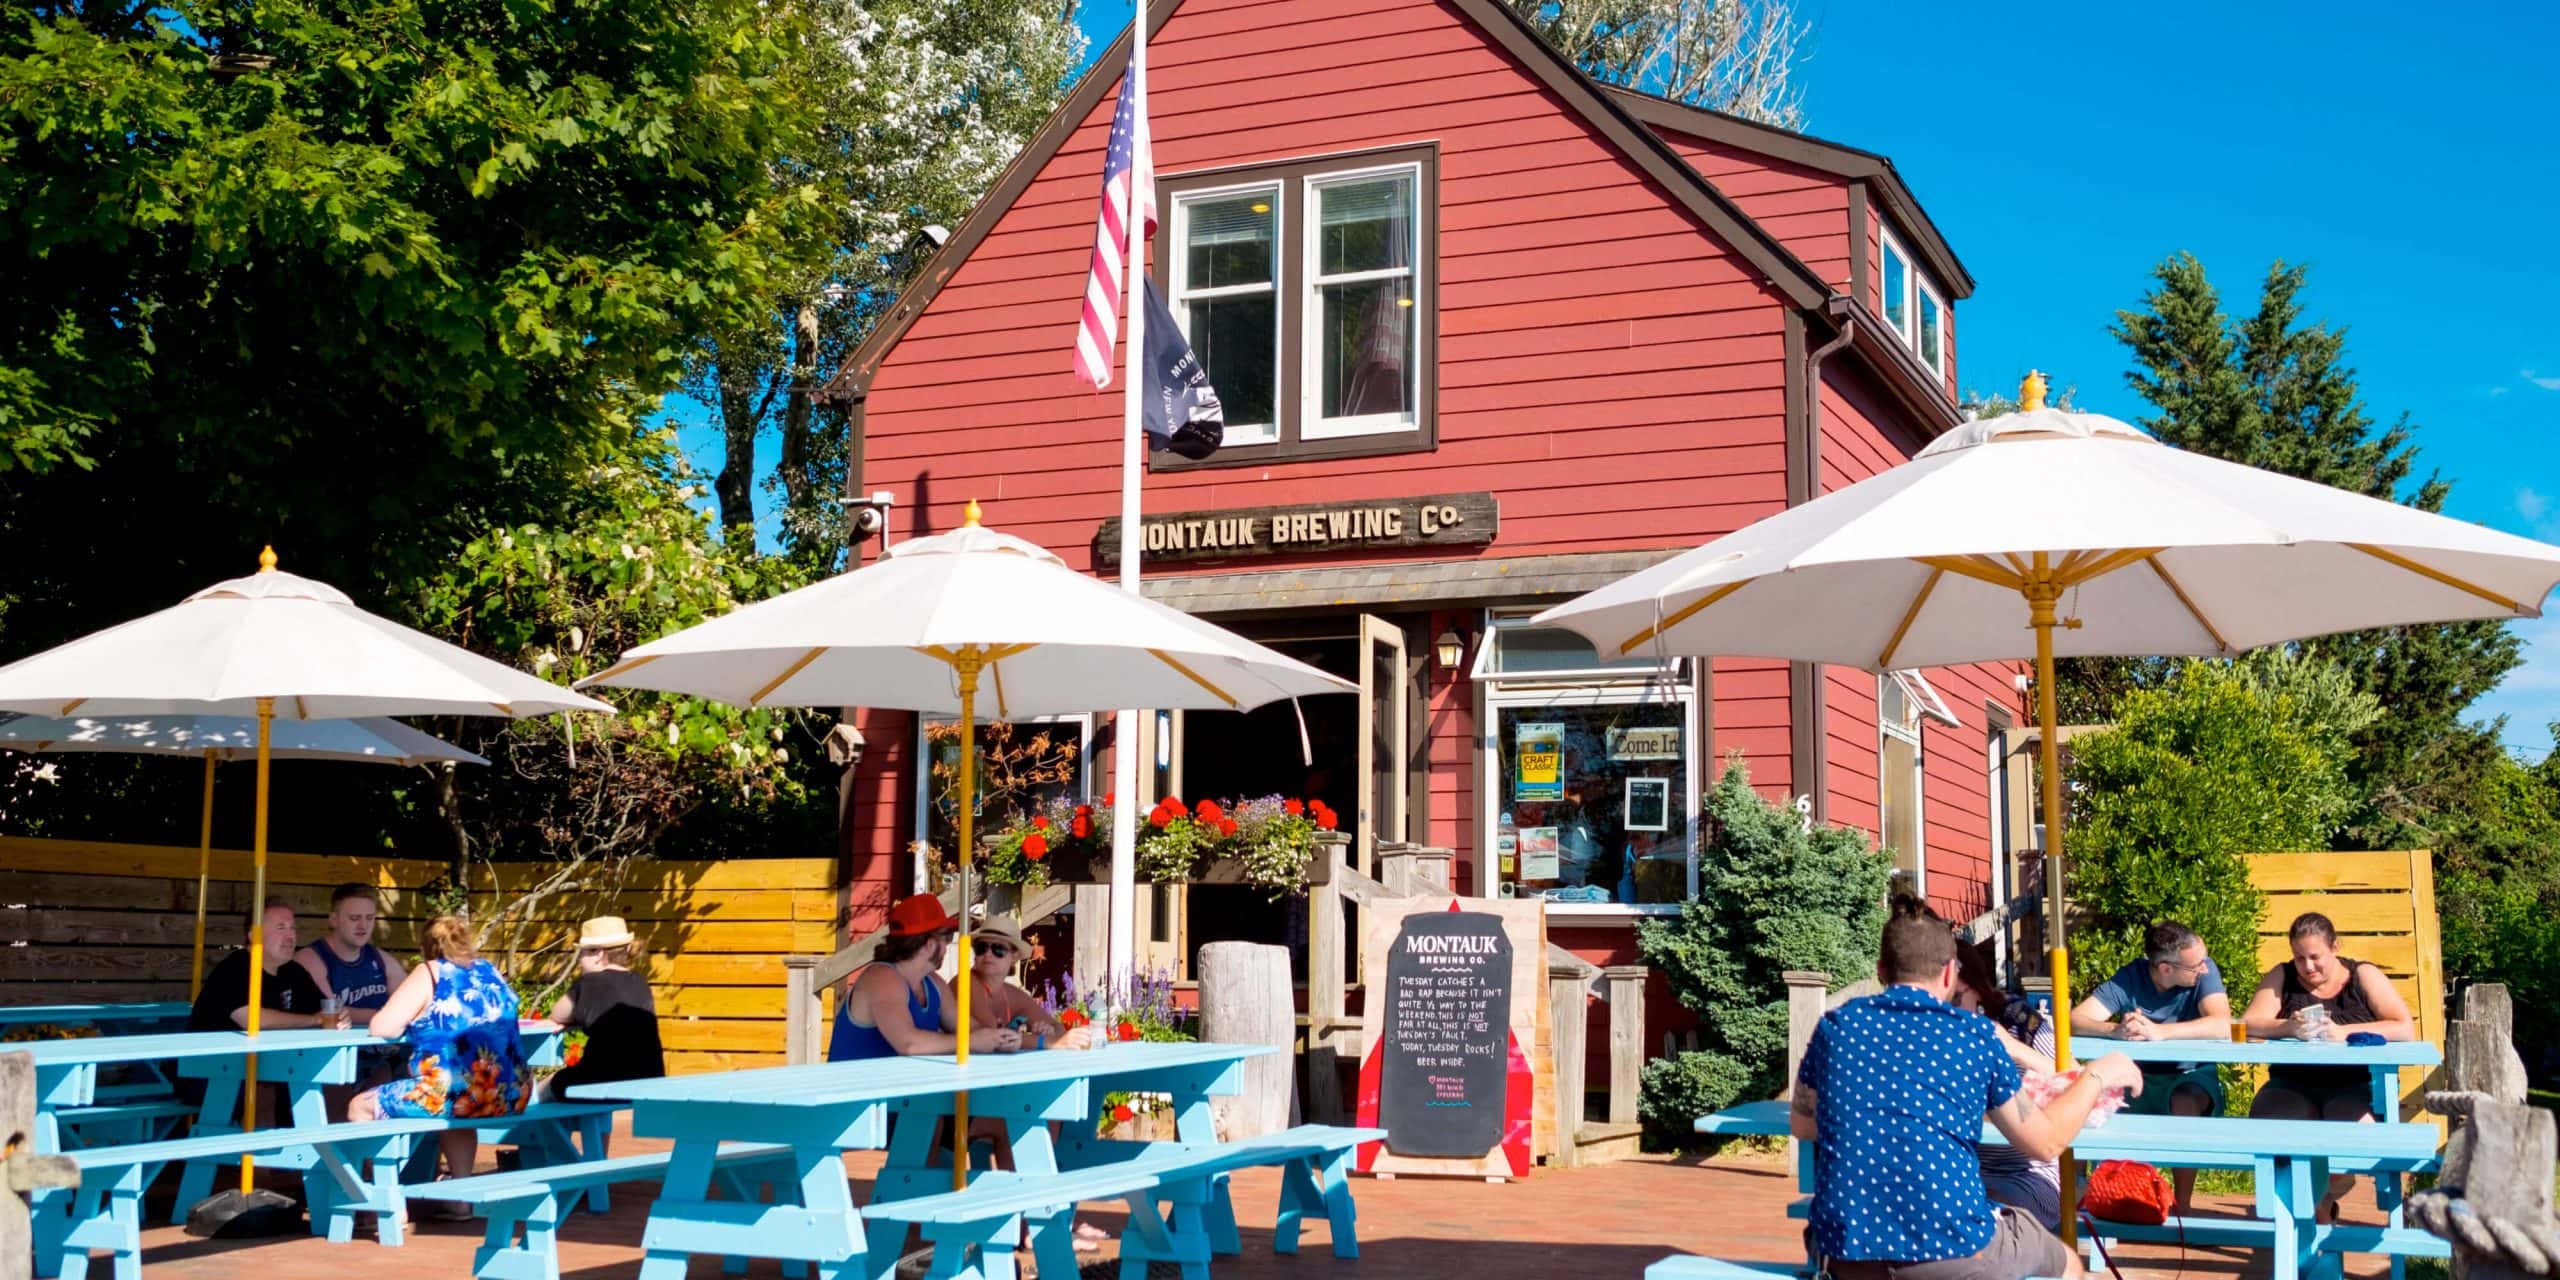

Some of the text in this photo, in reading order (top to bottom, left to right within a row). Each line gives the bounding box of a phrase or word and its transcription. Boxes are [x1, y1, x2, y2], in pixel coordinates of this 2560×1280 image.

[1272, 507, 1402, 544] BREWING
[1420, 504, 1465, 535] Co.
[1617, 735, 1658, 754] Come
[1523, 755, 1554, 764] CRAFT
[1406, 935, 1498, 954] MONTAUK
[1419, 956, 1486, 964] BREWING CO.
[1399, 976, 1486, 987] TUESDAY CATCHES A
[1400, 988, 1502, 998] BAD RAP BECAUSE IT ISN'T
[1398, 1000, 1421, 1009] QUITE
[1440, 1001, 1455, 1010] WAY
[1458, 1001, 1467, 1009] TO
[1470, 1001, 1487, 1009] THE
[1438, 1011, 1453, 1020] THIS
[1457, 1011, 1465, 1020] IS
[1468, 1011, 1486, 1021] NOT
[1398, 1020, 1414, 1029] FAIR
[1416, 1020, 1426, 1029] AT
[1442, 1022, 1458, 1030] THIS
[1463, 1022, 1470, 1030] IS
[1397, 1030, 1436, 1040] TUESDAY'S
[1400, 1040, 1495, 1059] TODAY, TUESDAY ROCKS!
[1417, 1057, 1437, 1066] BEER
